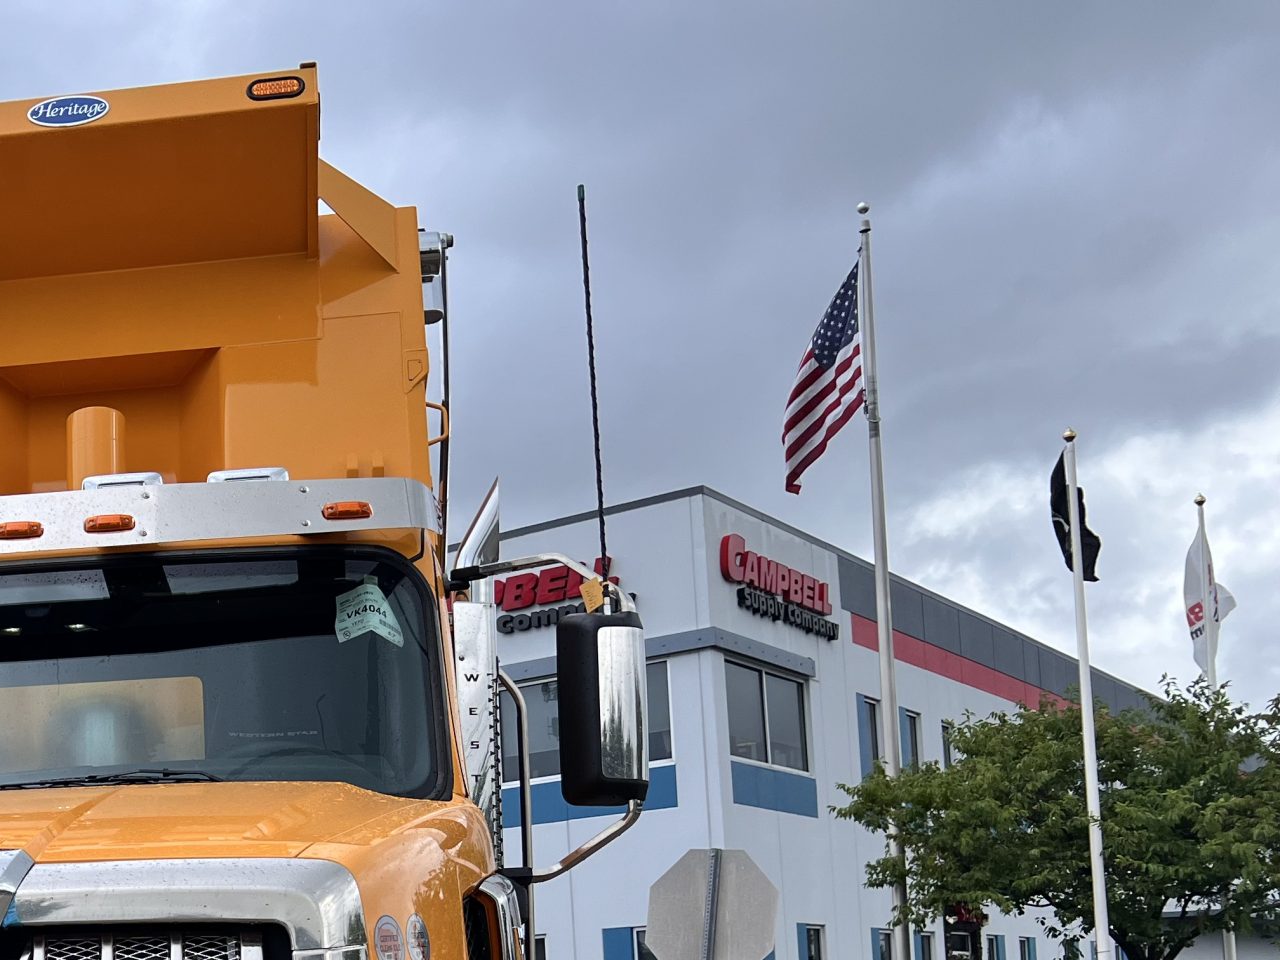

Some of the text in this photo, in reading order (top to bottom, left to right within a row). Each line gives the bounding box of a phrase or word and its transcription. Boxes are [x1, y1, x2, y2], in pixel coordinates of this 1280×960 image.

[32, 101, 105, 119] Heritage
[720, 533, 832, 616] CAMPBELL
[346, 604, 387, 618] VK4044
